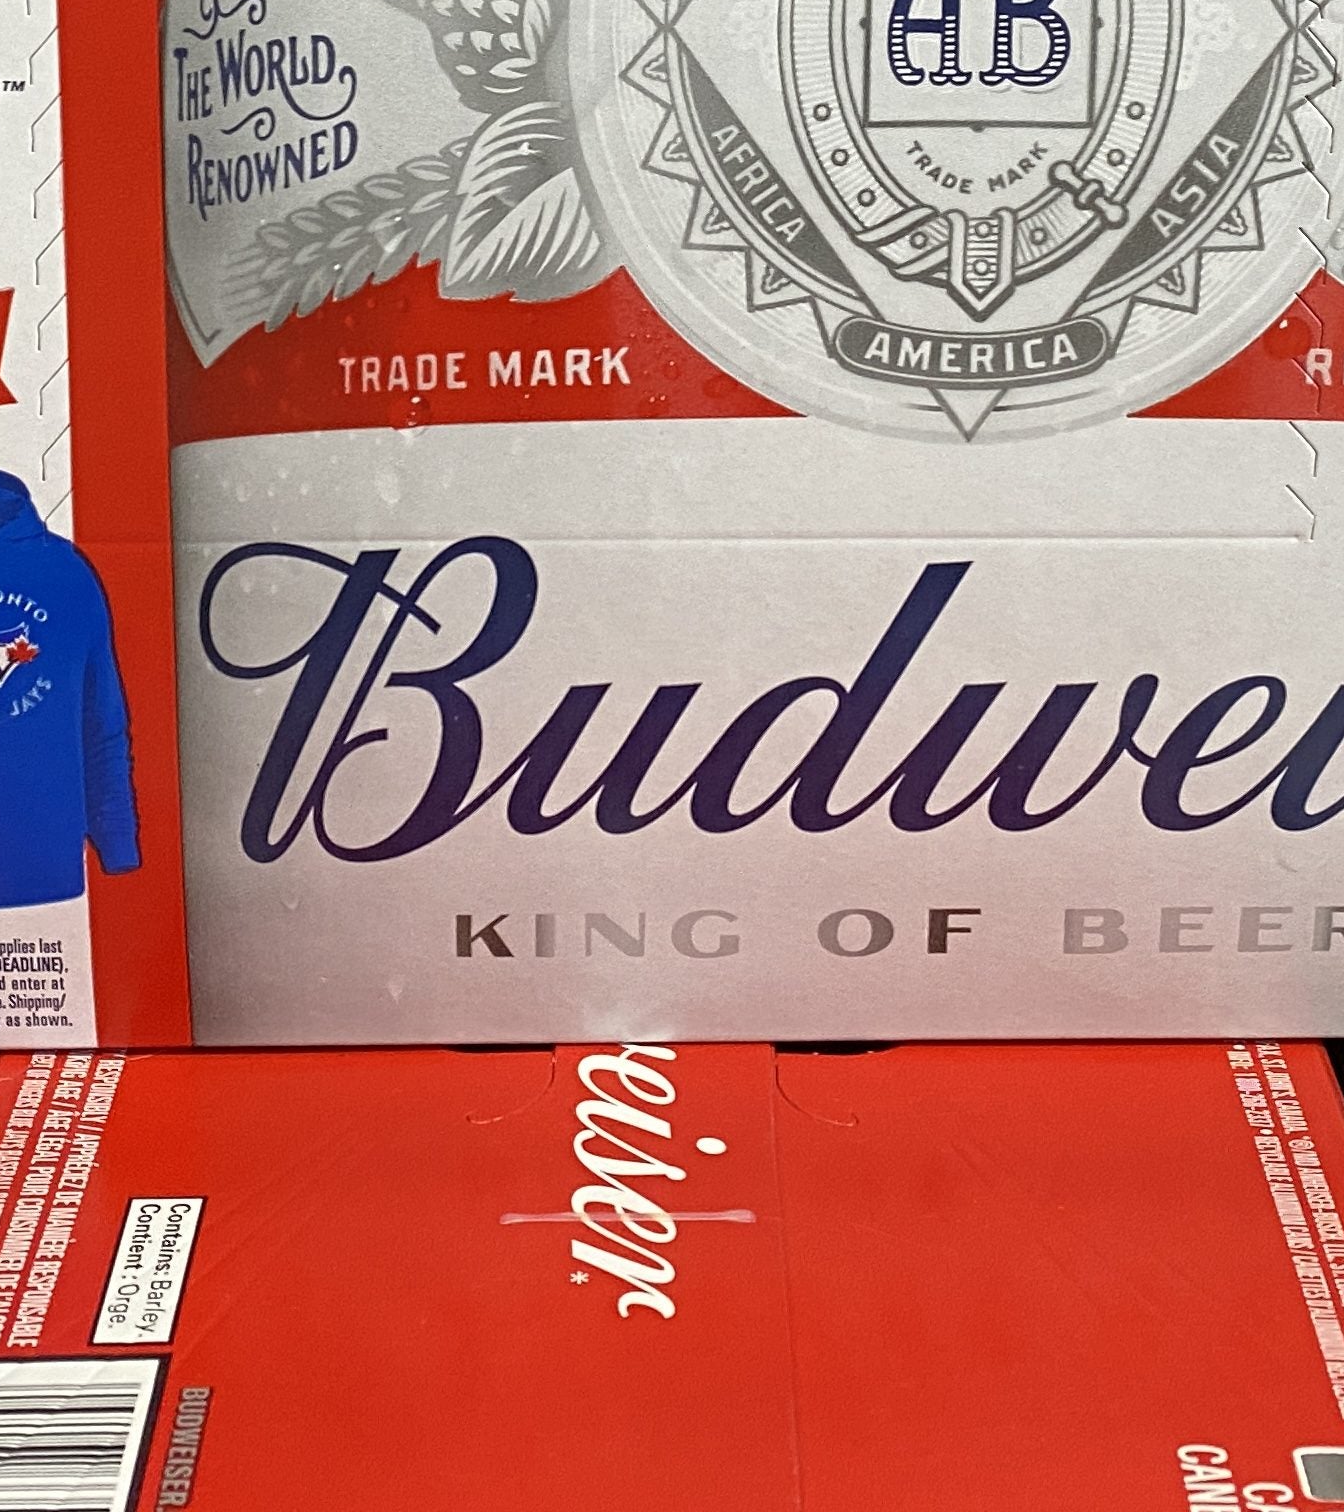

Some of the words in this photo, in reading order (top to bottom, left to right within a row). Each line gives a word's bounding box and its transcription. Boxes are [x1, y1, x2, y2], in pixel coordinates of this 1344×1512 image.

[174, 47, 212, 122] THE
[711, 124, 806, 244] AFRICA
[906, 139, 972, 194] TRADE
[988, 140, 1048, 193] MARK
[1154, 133, 1240, 239] ASIA
[339, 352, 466, 395] TRADE
[489, 347, 631, 388] MARK
[864, 333, 1079, 372] AMERICA
[10, 676, 52, 718] JAYS
[39, 940, 63, 953] last
[454, 905, 745, 959] KING
[817, 905, 981, 957] OF
[571, 1041, 726, 1319] eiser
[124, 1203, 161, 1270] Contient
[154, 1203, 191, 1276] Contains:
[107, 1283, 140, 1329] Orge.
[136, 1280, 172, 1338] Barley.
